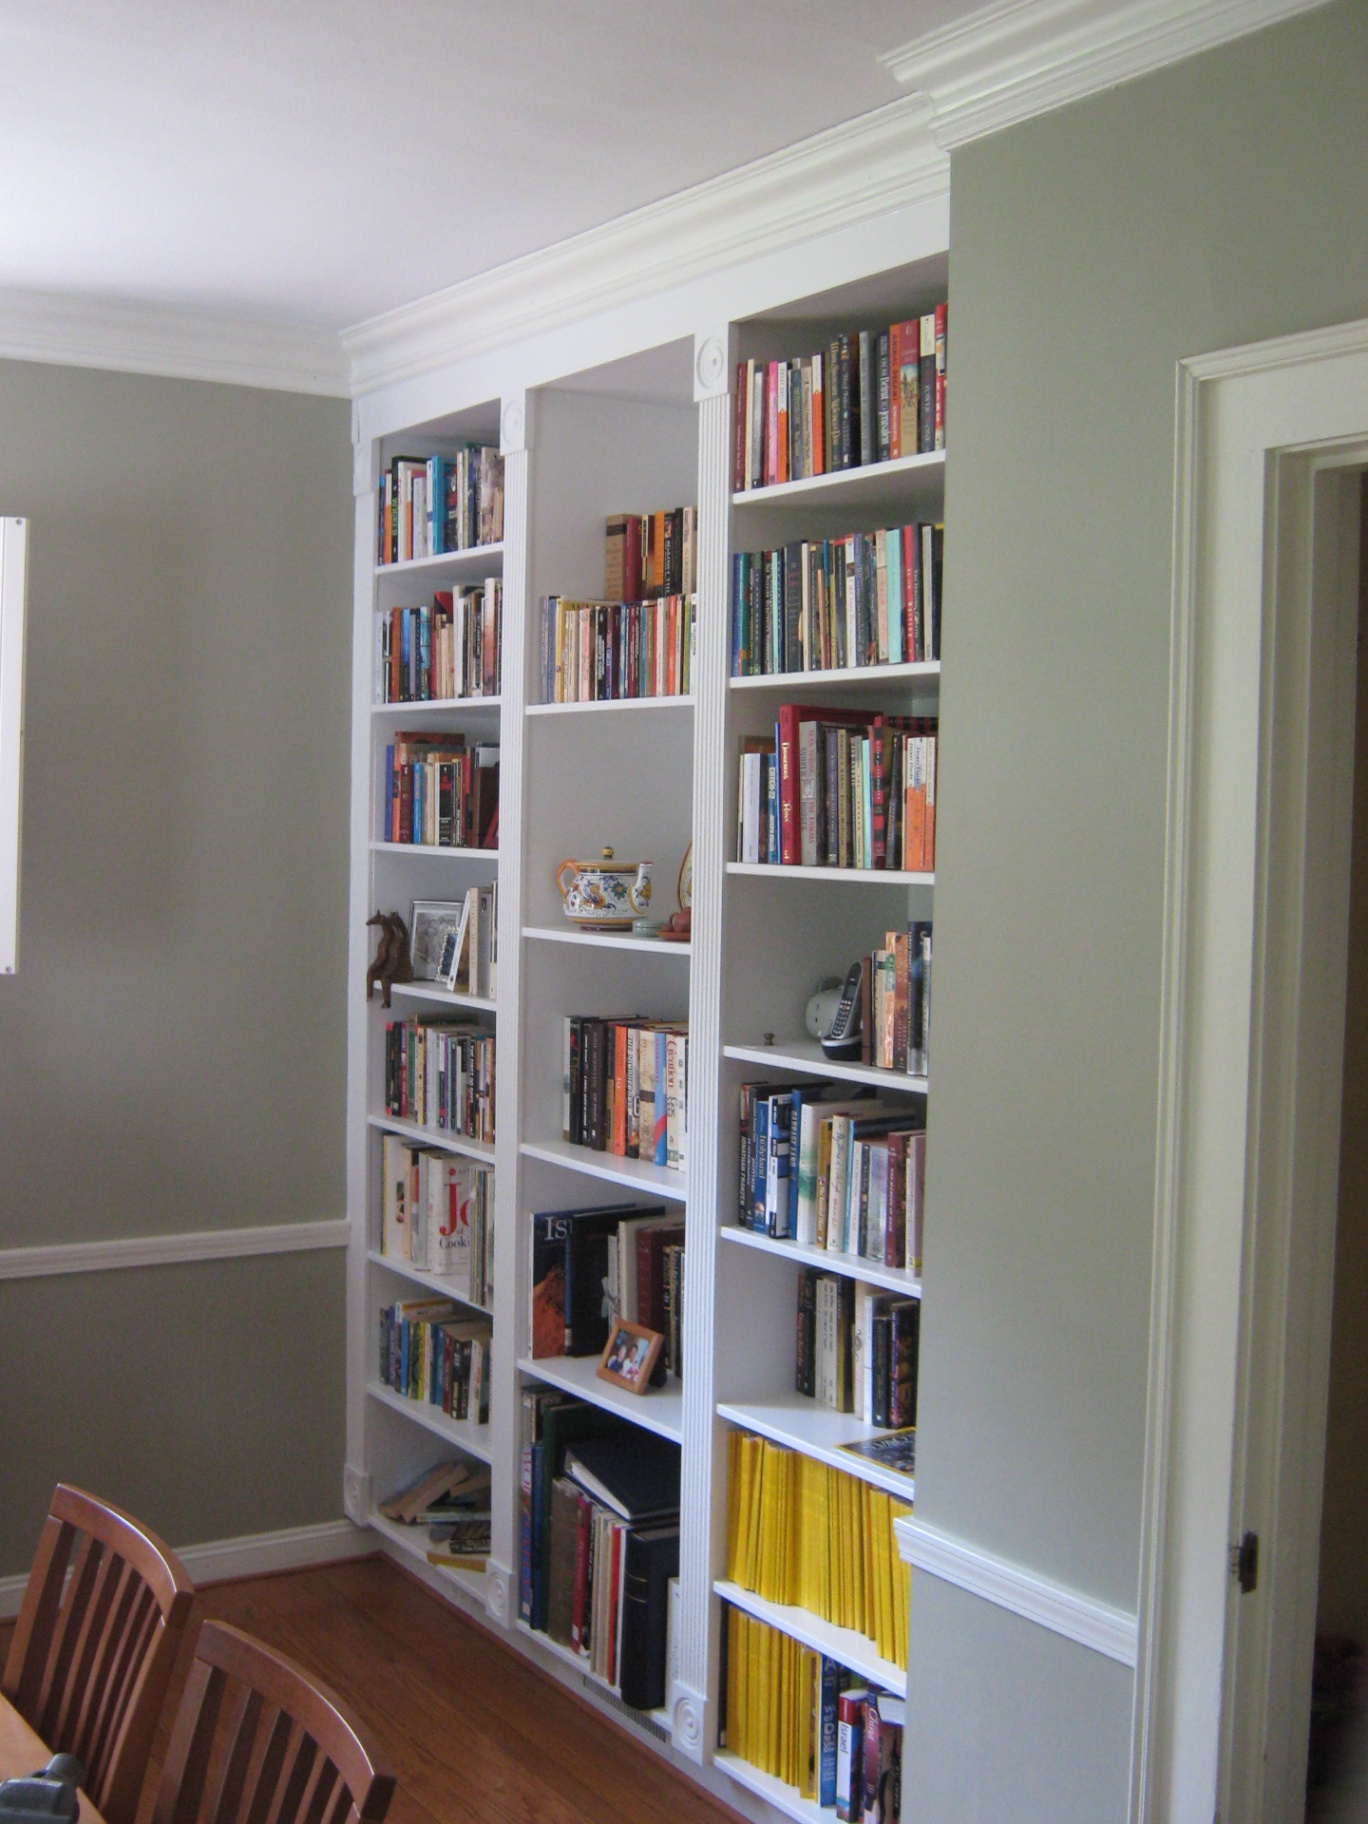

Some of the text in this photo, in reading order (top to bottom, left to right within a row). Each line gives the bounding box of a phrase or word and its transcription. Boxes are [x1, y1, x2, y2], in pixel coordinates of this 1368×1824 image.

[880, 377, 890, 400] Beirut
[878, 411, 890, 445] Jerusalem
[666, 1040, 678, 1088] Creation
[758, 1135, 767, 1179] holy land
[522, 1450, 532, 1599] WORLD ATLAS
[838, 1723, 850, 1754] Israel
[868, 1708, 880, 1741] China
